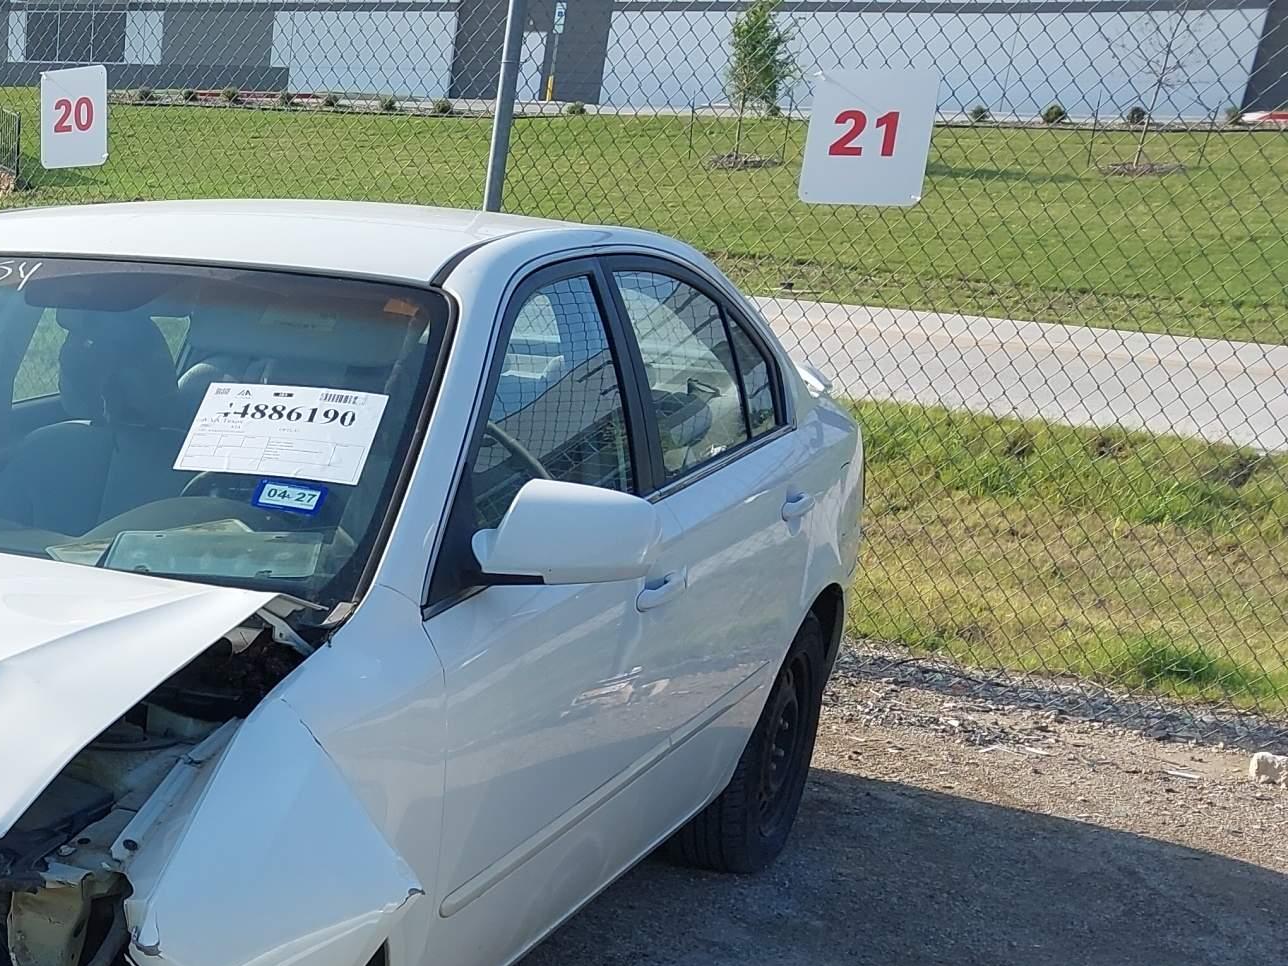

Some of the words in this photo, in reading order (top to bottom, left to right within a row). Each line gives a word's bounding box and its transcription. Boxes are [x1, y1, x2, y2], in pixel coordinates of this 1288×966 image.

[54, 96, 94, 133] 20
[828, 109, 900, 157] 21
[267, 488, 288, 500] 04
[294, 492, 318, 503] 27
